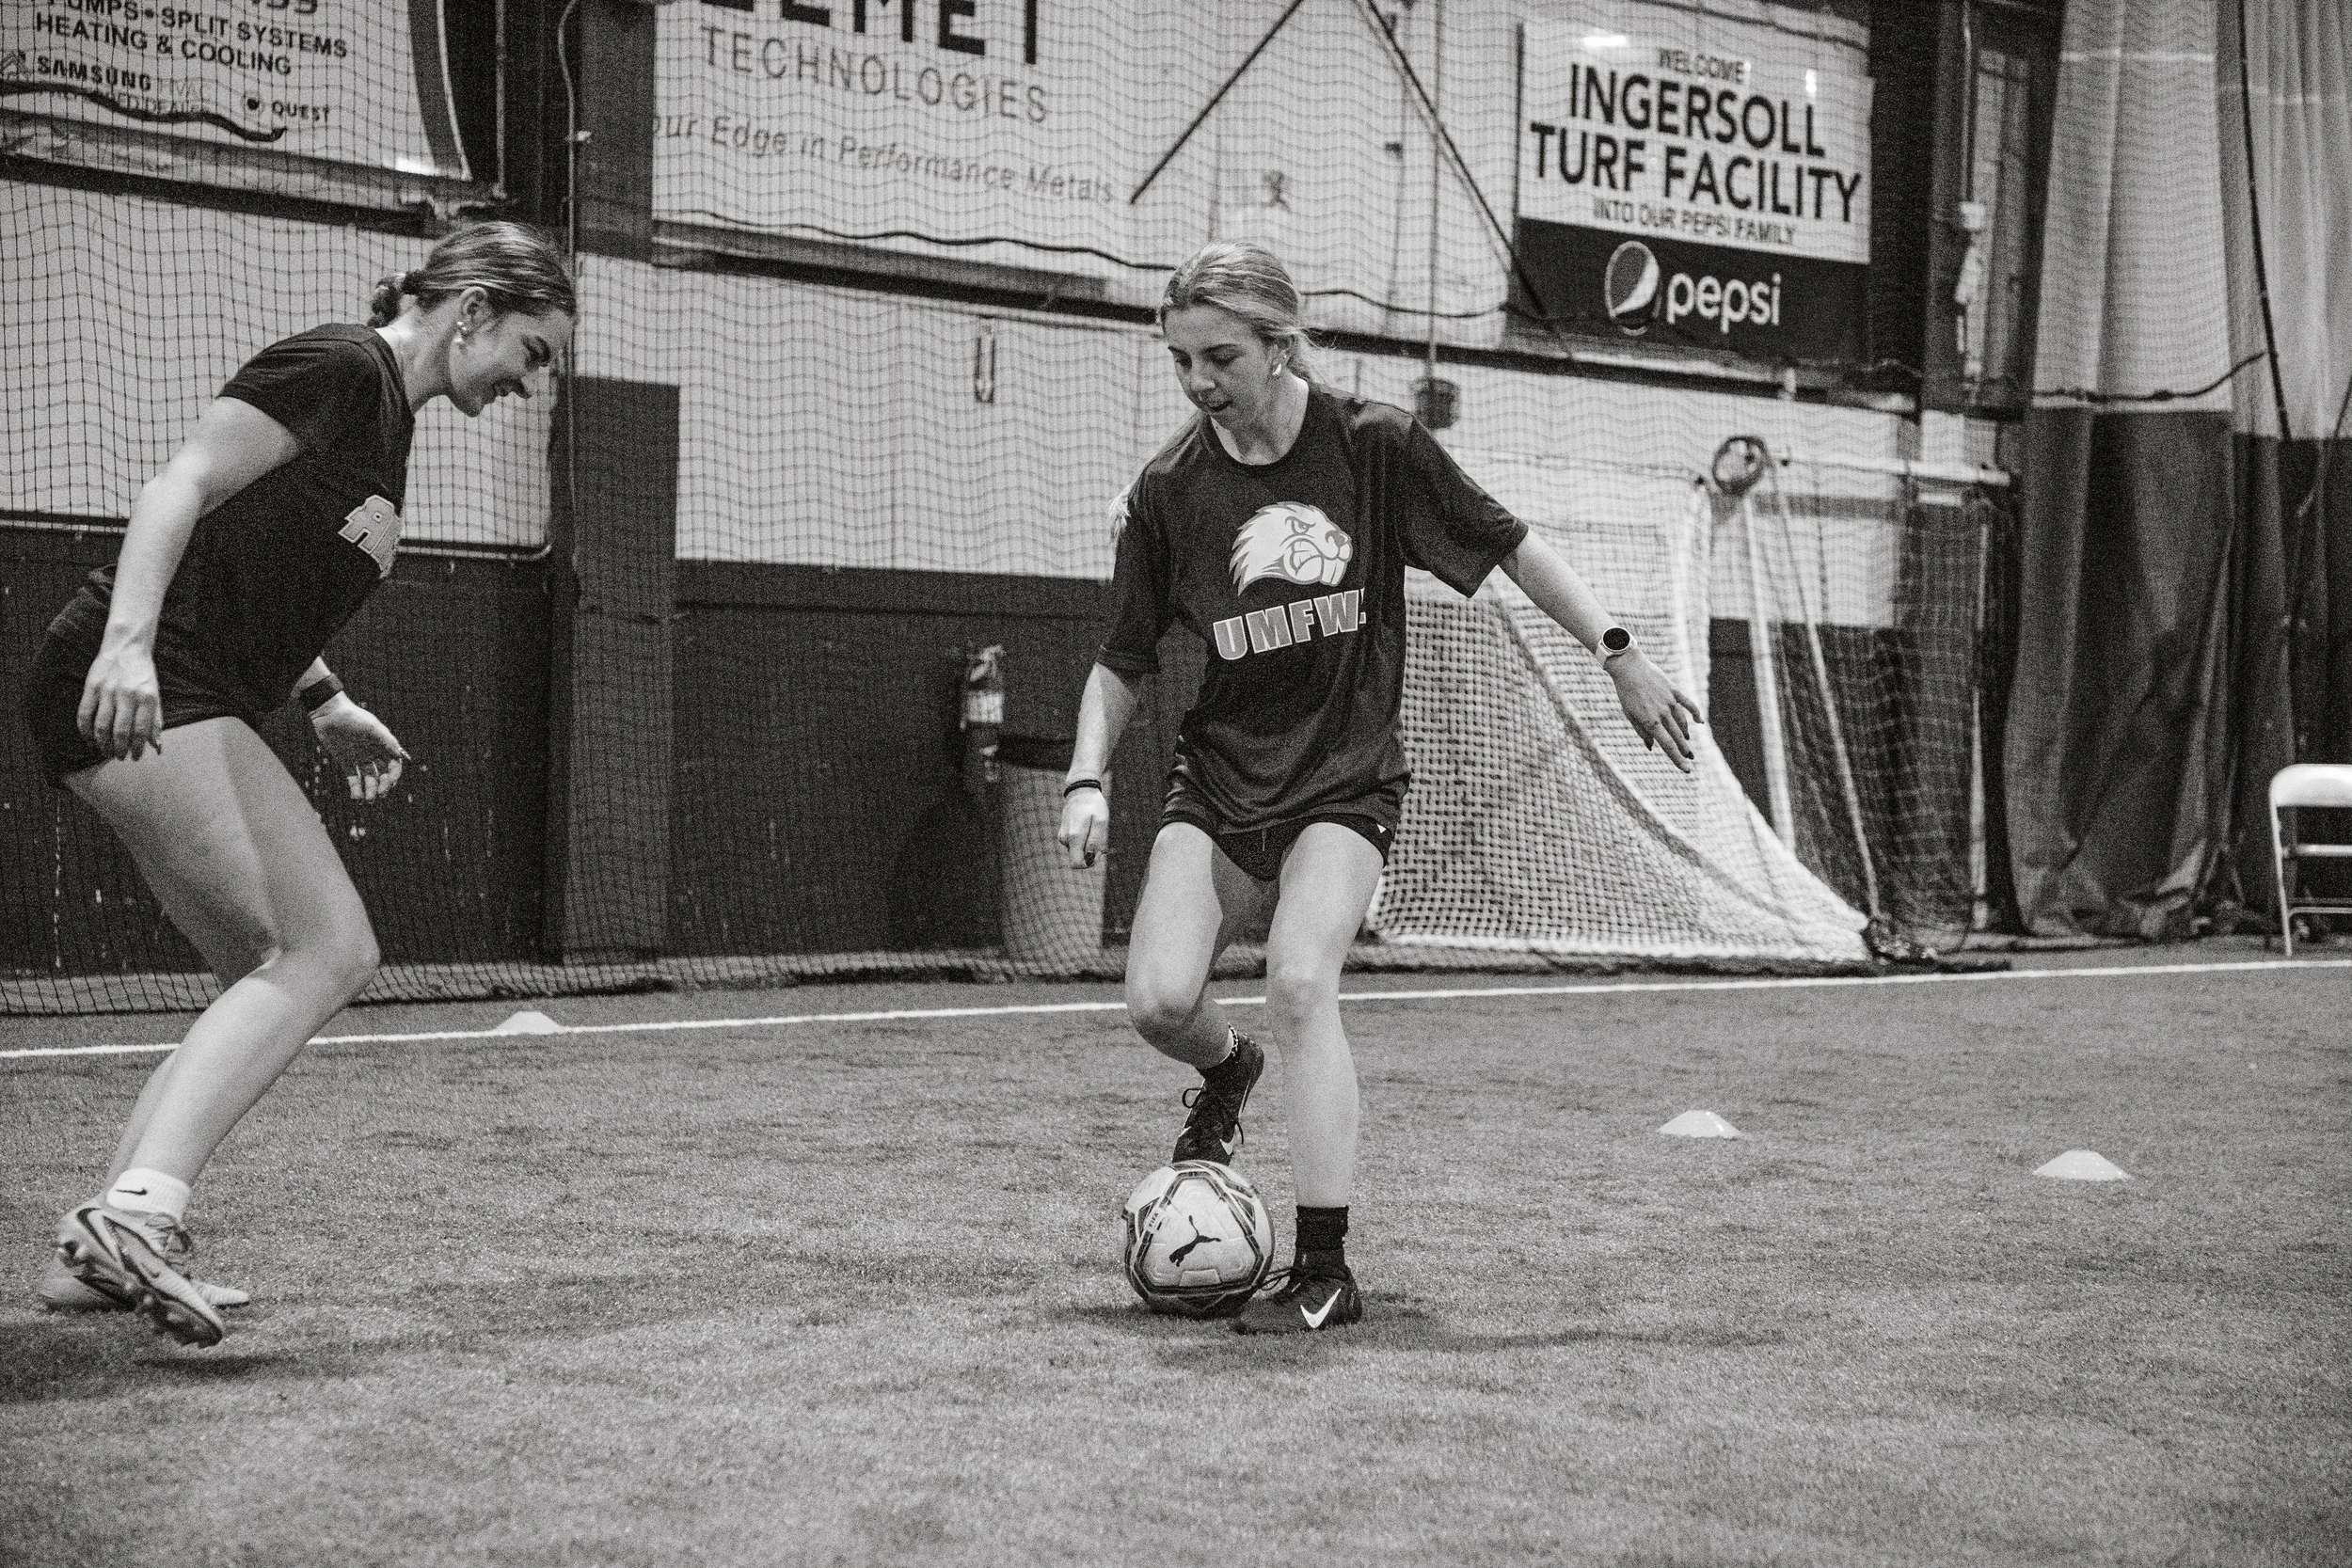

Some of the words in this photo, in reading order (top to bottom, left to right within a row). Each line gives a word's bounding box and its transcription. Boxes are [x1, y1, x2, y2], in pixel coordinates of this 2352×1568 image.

[36, 11, 148, 50] HEATING
[157, 34, 172, 54] &
[181, 40, 292, 75] COOLING
[237, 21, 347, 58] SYSTEMS
[1657, 46, 1744, 85] WELCOME
[38, 55, 151, 91] SAMSUNG
[701, 24, 1046, 123] TECHNOLOGIES
[271, 100, 329, 122] QUEST
[1570, 62, 1826, 157] INGERSOLL
[712, 115, 787, 158] Edge
[800, 136, 824, 159] in
[840, 135, 1016, 189] Performance
[1027, 163, 1111, 203] Metals
[1530, 121, 1645, 192] TURF
[1664, 146, 1862, 224] FACILITY
[1593, 197, 1635, 224] INTO
[1639, 202, 1677, 230] OUR
[1681, 209, 1731, 239] PEPSI
[1735, 216, 1796, 246] FAMILY
[1666, 271, 1782, 335] pepsi
